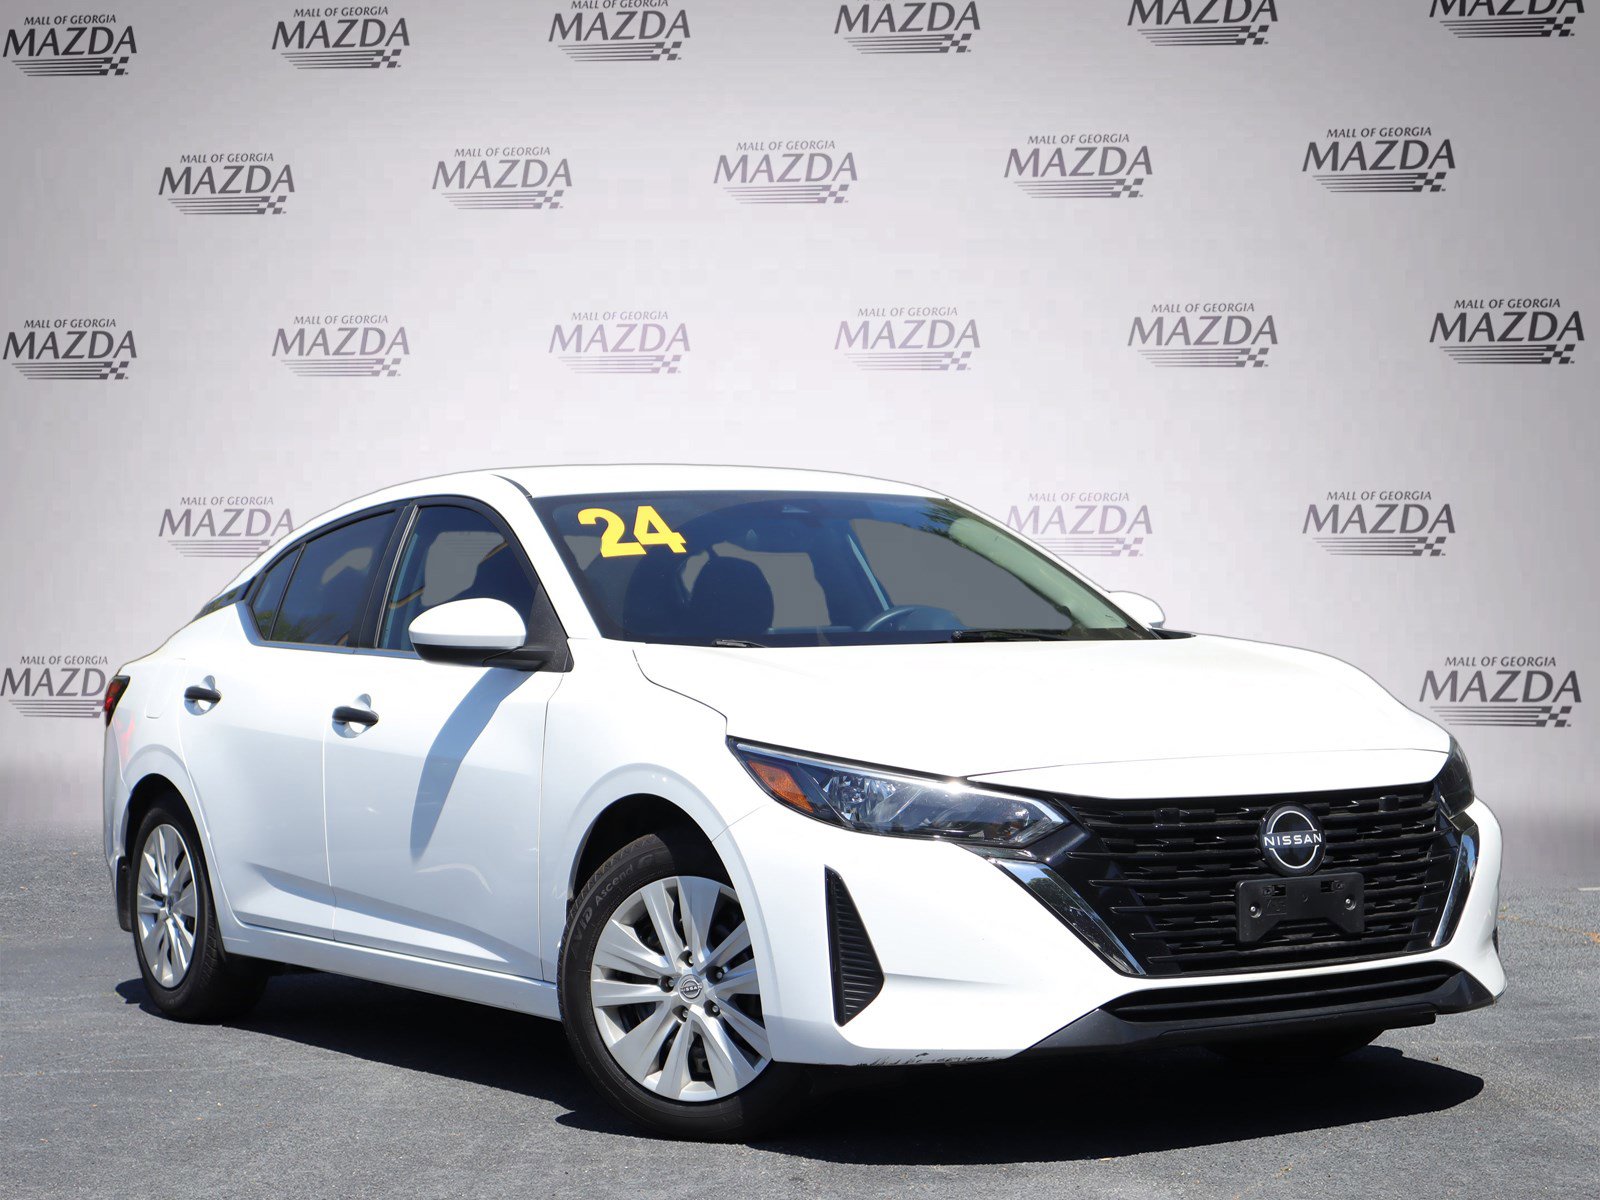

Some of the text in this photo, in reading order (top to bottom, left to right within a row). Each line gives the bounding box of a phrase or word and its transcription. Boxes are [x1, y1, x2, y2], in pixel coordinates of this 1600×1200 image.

[293, 6, 389, 18] MALL OF GEORGIA
[571, 0, 669, 9] MALL OF GEORGIA
[834, 1, 981, 34] MAZDA
[1127, 0, 1279, 26] MAZDA
[23, 14, 117, 26] MALL OF GEORGIA
[548, 9, 691, 42] MAZDA
[3, 26, 138, 57] MAZDA
[271, 18, 410, 50] MAZDA
[736, 140, 836, 151] MALL OF GEORGIA
[1027, 133, 1130, 145] MALL OF GEORGIA
[1326, 126, 1432, 138] MALL OF GEORGIA
[180, 153, 274, 163] MALL OF GEORGIA
[454, 147, 551, 157] MALL OF GEORGIA
[1004, 145, 1153, 178] MAZDA
[1302, 139, 1456, 172] MAZDA
[158, 164, 295, 195] MAZDA
[432, 158, 573, 190] MAZDA
[713, 152, 858, 184] MAZDA
[571, 311, 669, 321] MALL OF GEORGIA
[858, 306, 958, 317] MALL OF GEORGIA
[1151, 302, 1255, 313] MALL OF GEORGIA
[1454, 298, 1561, 309] MALL OF GEORGIA
[23, 319, 117, 329] MALL OF GEORGIA
[293, 315, 389, 325] MALL OF GEORGIA
[1127, 315, 1279, 346] MAZDA
[1429, 311, 1585, 343] MAZDA
[3, 330, 138, 360] MAZDA
[271, 327, 410, 357] MAZDA
[548, 323, 691, 353] MAZDA
[834, 319, 981, 350] MAZDA
[180, 496, 274, 506] MALL OF GEORGIA
[1028, 492, 1130, 502] MALL OF GEORGIA
[1326, 490, 1432, 501] MALL OF GEORGIA
[158, 508, 295, 537] MAZDA
[577, 505, 687, 558] 24
[1006, 504, 1153, 535] MAZDA
[1302, 503, 1456, 534] MAZDA
[20, 655, 109, 665] MALL OF GEORGIA
[1445, 656, 1557, 667] MALL OF GEORGIA
[0, 667, 106, 697] MAZD
[1419, 670, 1582, 703] MAZDA
[1264, 833, 1322, 847] NISSAN
